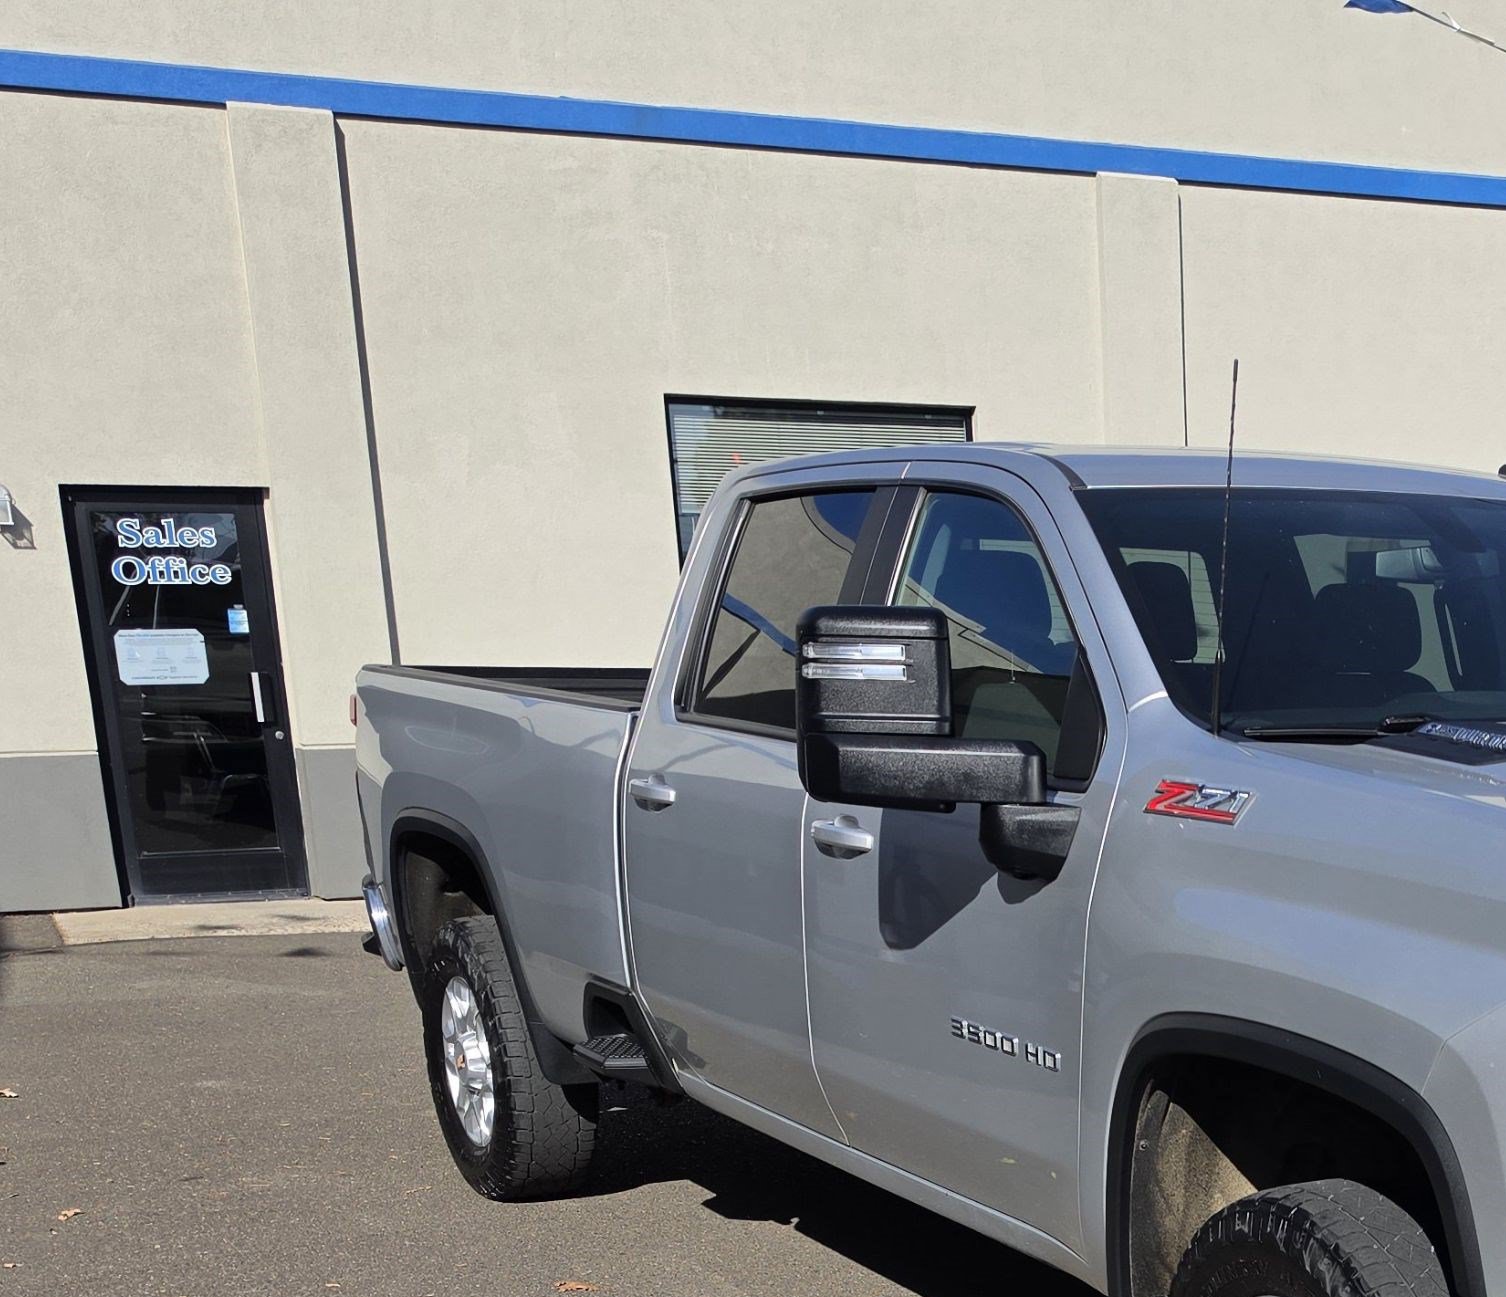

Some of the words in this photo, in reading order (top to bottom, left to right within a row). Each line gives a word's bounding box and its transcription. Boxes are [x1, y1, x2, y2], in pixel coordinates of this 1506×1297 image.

[116, 517, 218, 548] Sales
[111, 555, 233, 586] Office
[1143, 779, 1257, 828] Z71
[950, 1015, 1019, 1058] 3500
